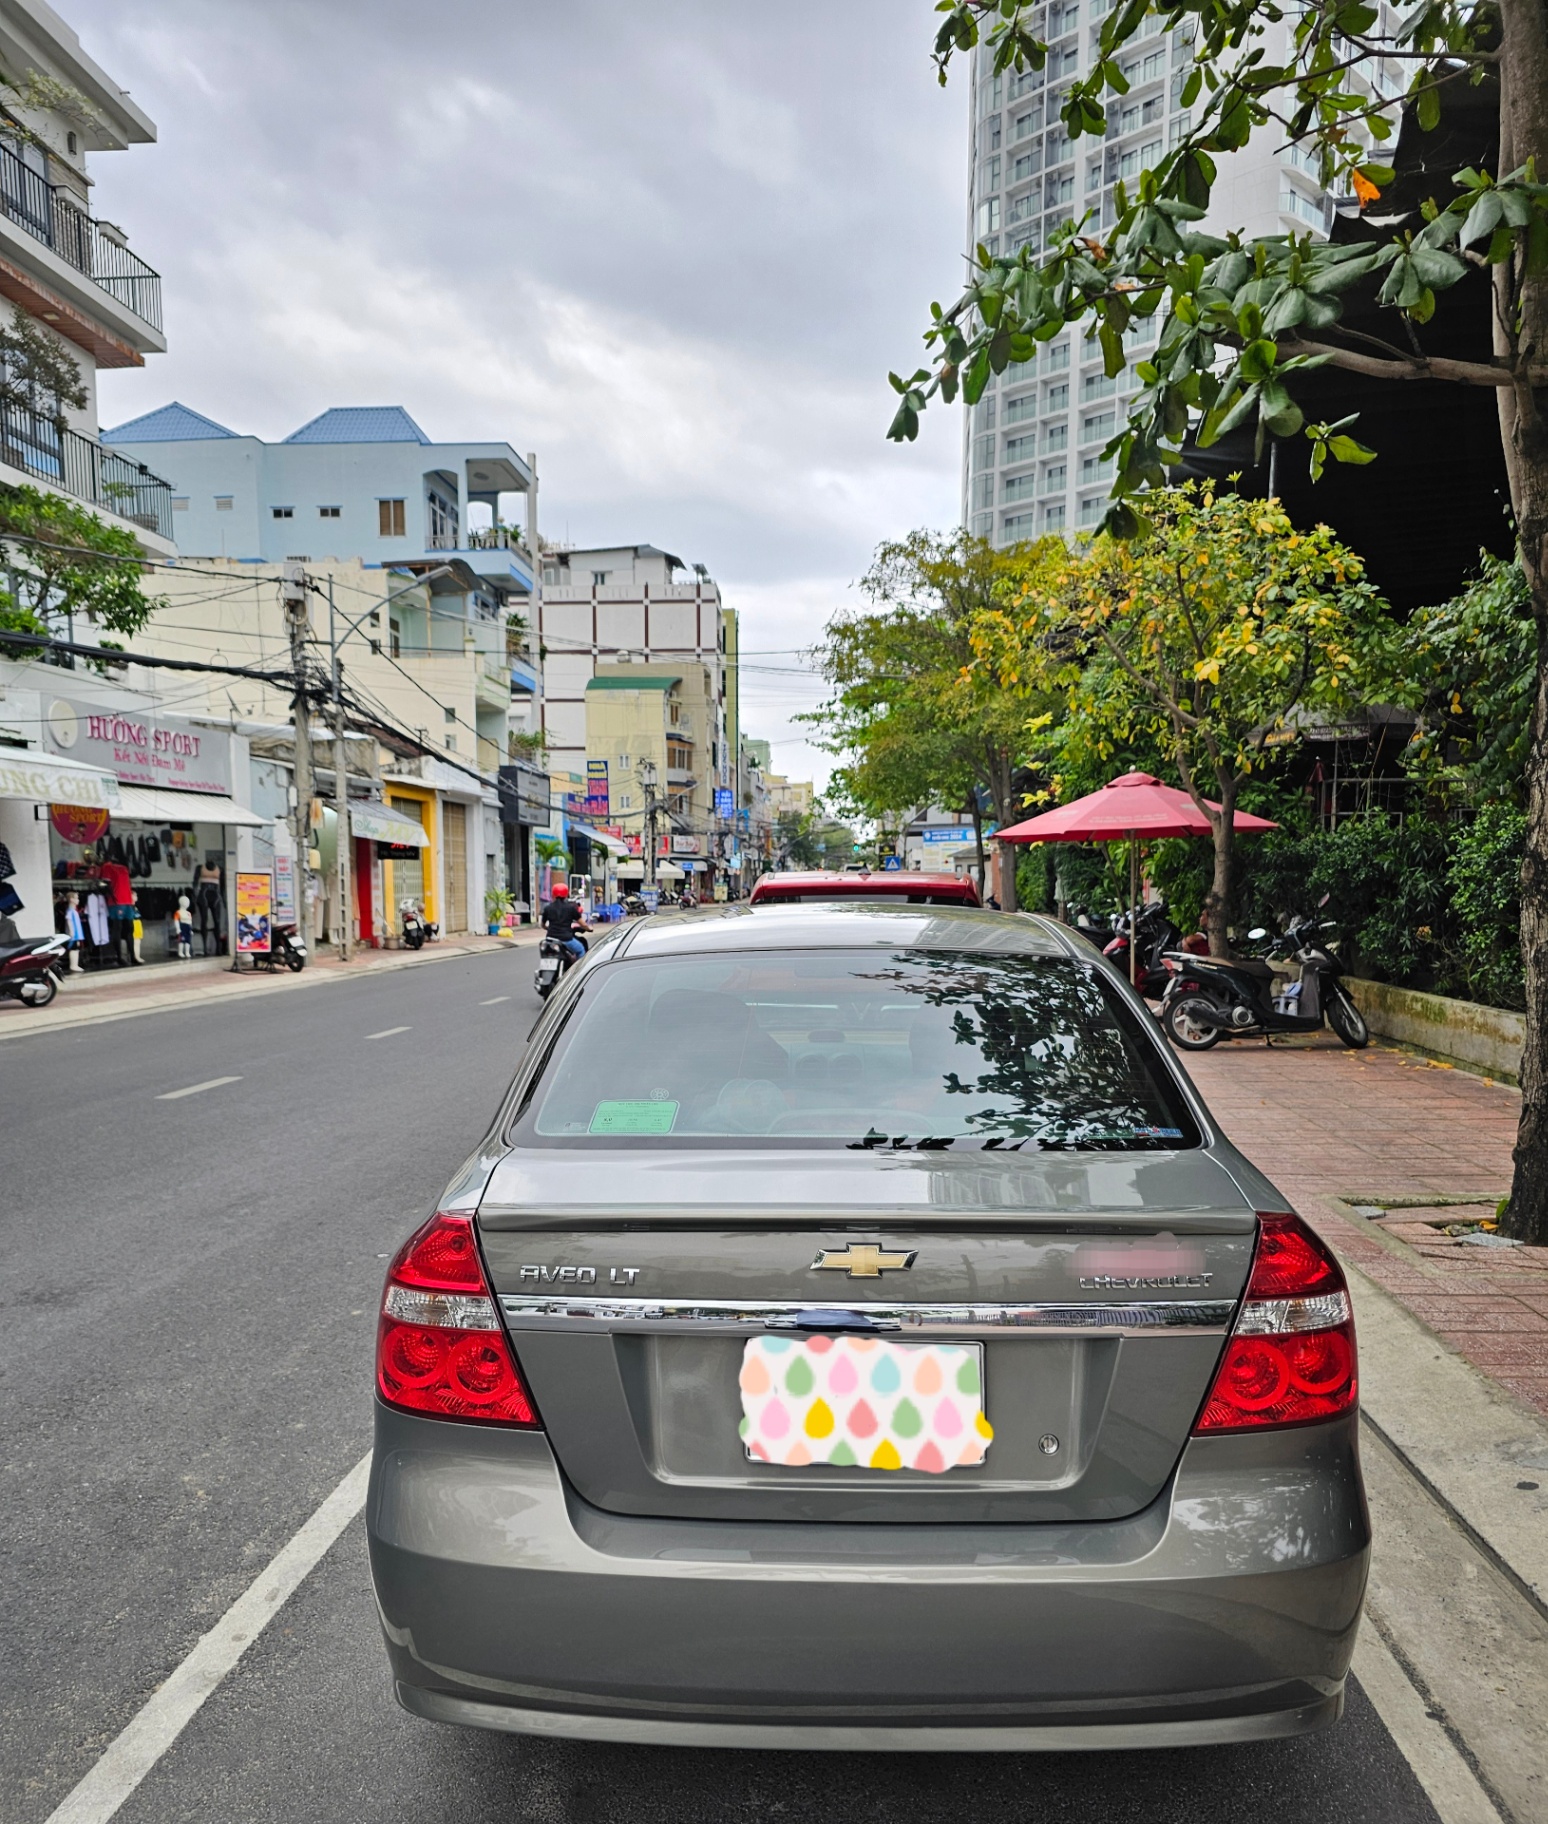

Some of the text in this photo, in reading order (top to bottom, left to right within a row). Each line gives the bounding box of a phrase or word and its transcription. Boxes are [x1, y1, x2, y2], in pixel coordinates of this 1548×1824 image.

[151, 728, 201, 757] SPORT
[520, 1265, 640, 1285] AVEO LT
